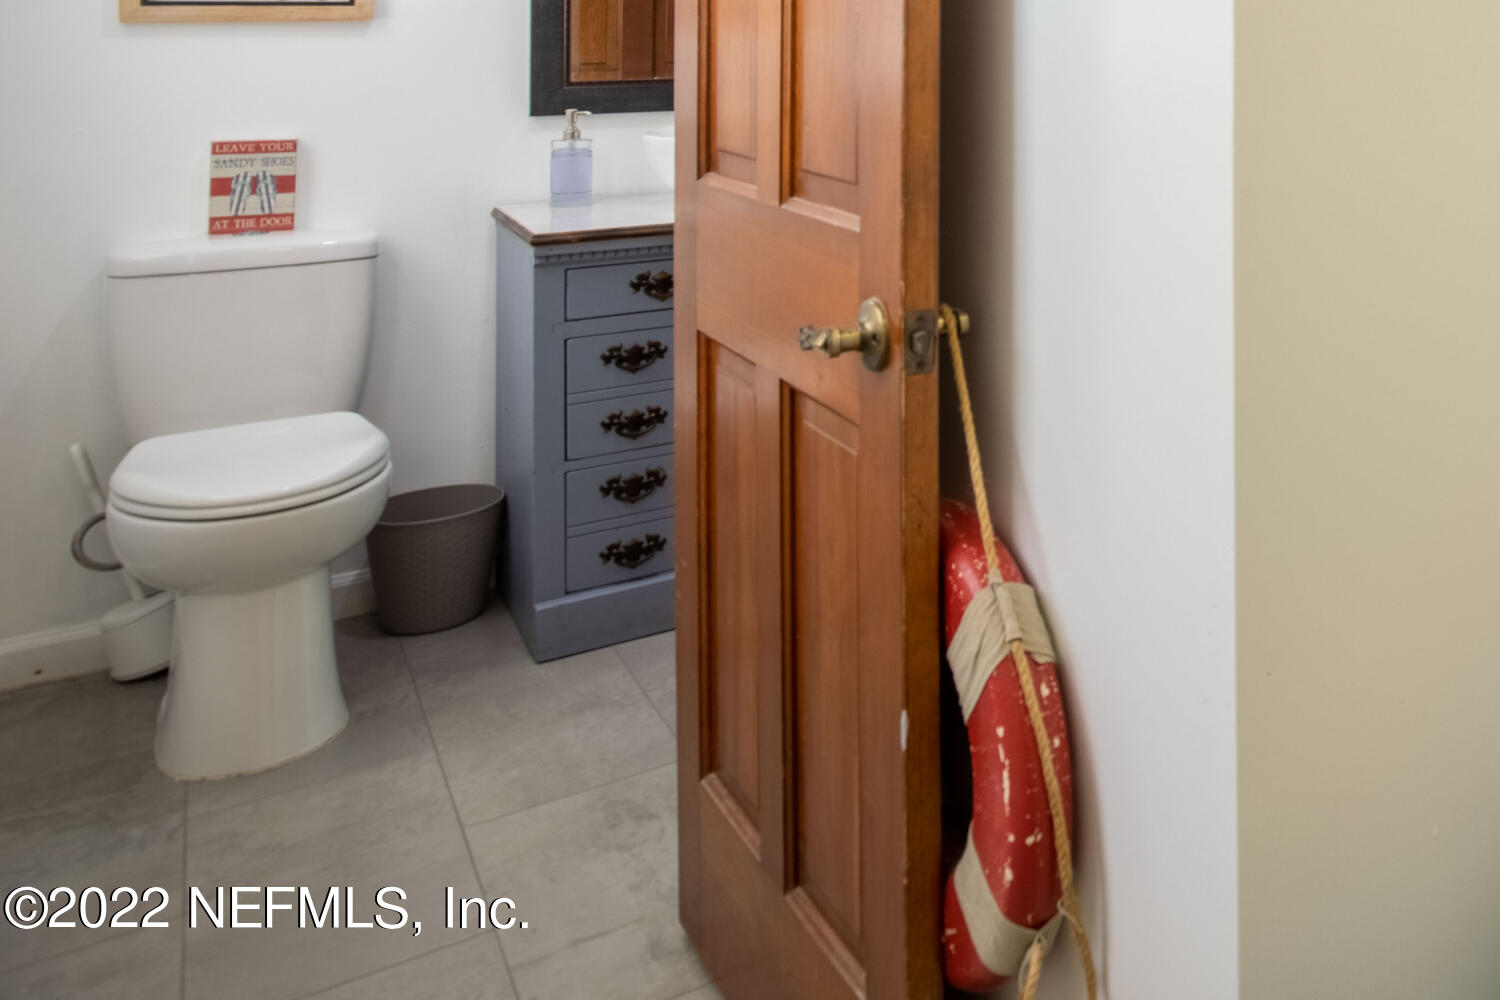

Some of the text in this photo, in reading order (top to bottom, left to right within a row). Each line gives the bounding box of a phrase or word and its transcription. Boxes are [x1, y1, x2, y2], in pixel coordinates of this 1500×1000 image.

[215, 142, 294, 153] LEAVE YOUR
[213, 156, 296, 168] SANDY SHOES
[213, 216, 292, 230] AT THE DOOR
